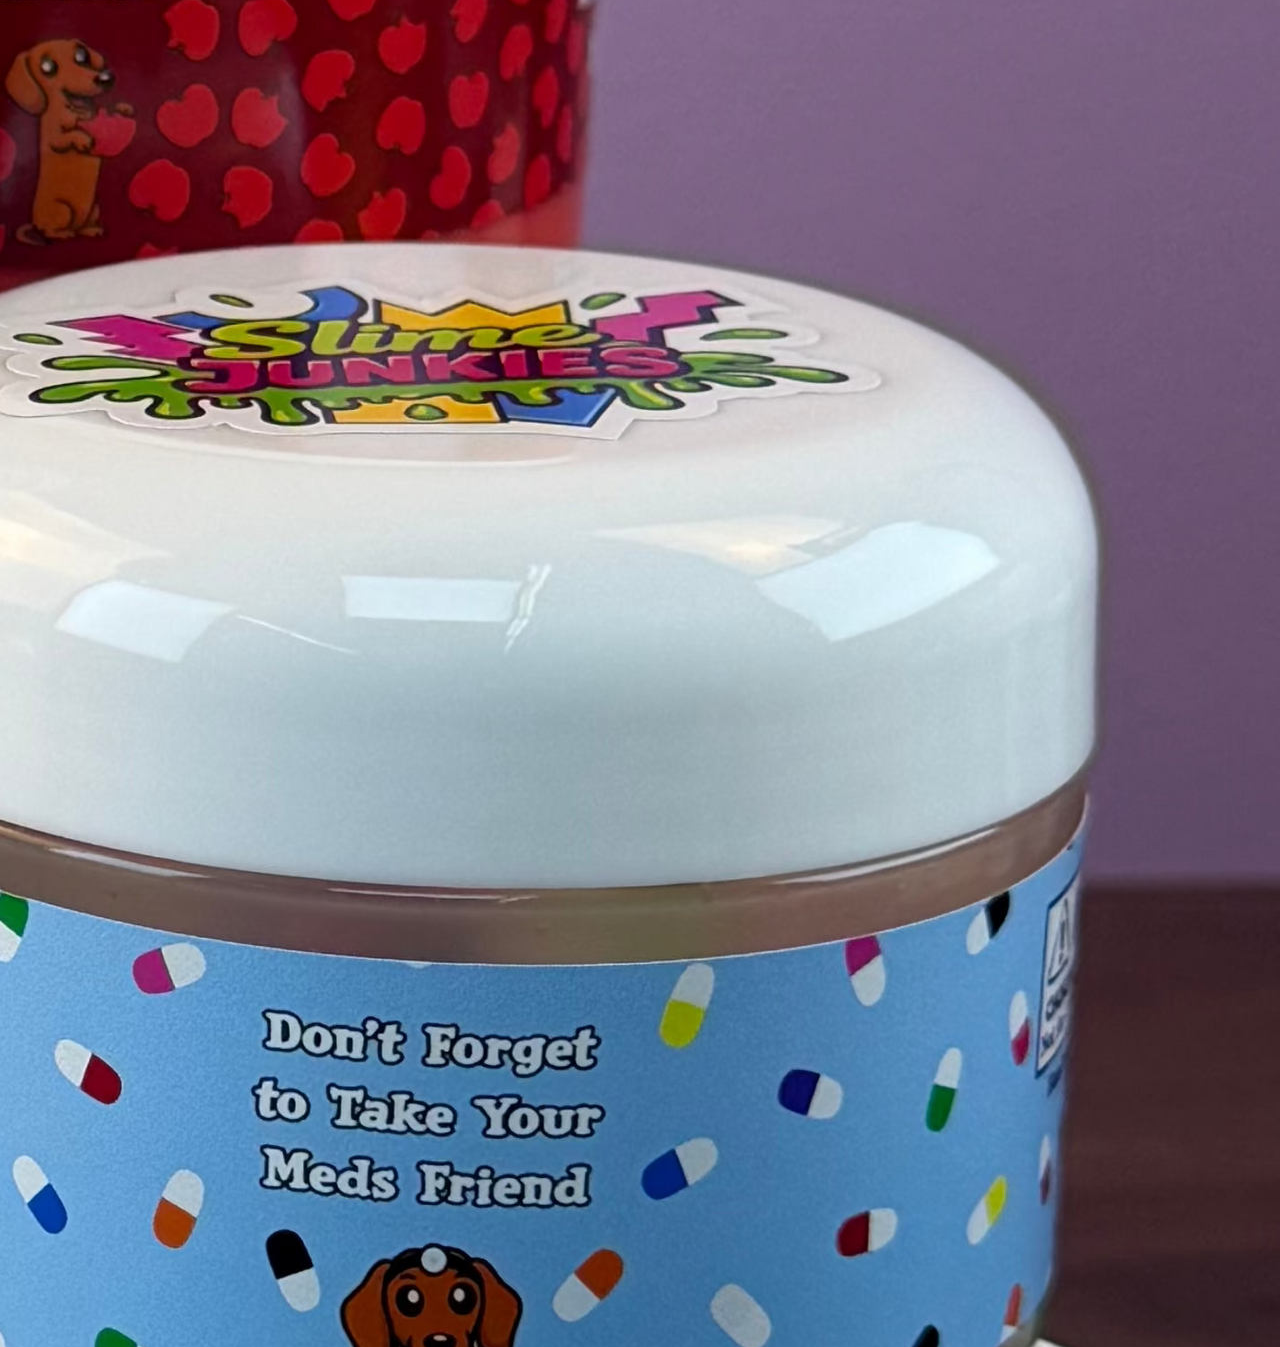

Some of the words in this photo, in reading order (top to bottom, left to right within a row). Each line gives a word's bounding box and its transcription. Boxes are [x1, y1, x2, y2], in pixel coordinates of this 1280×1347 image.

[188, 344, 683, 393] JUNKIES
[208, 318, 604, 361] Slime
[261, 1009, 408, 1066] Don't
[421, 1022, 603, 1079] Forget
[251, 1076, 311, 1122] to
[326, 1082, 458, 1136] Take
[471, 1094, 606, 1139] Your
[260, 1144, 400, 1203] Meds
[416, 1160, 593, 1209] Friend
